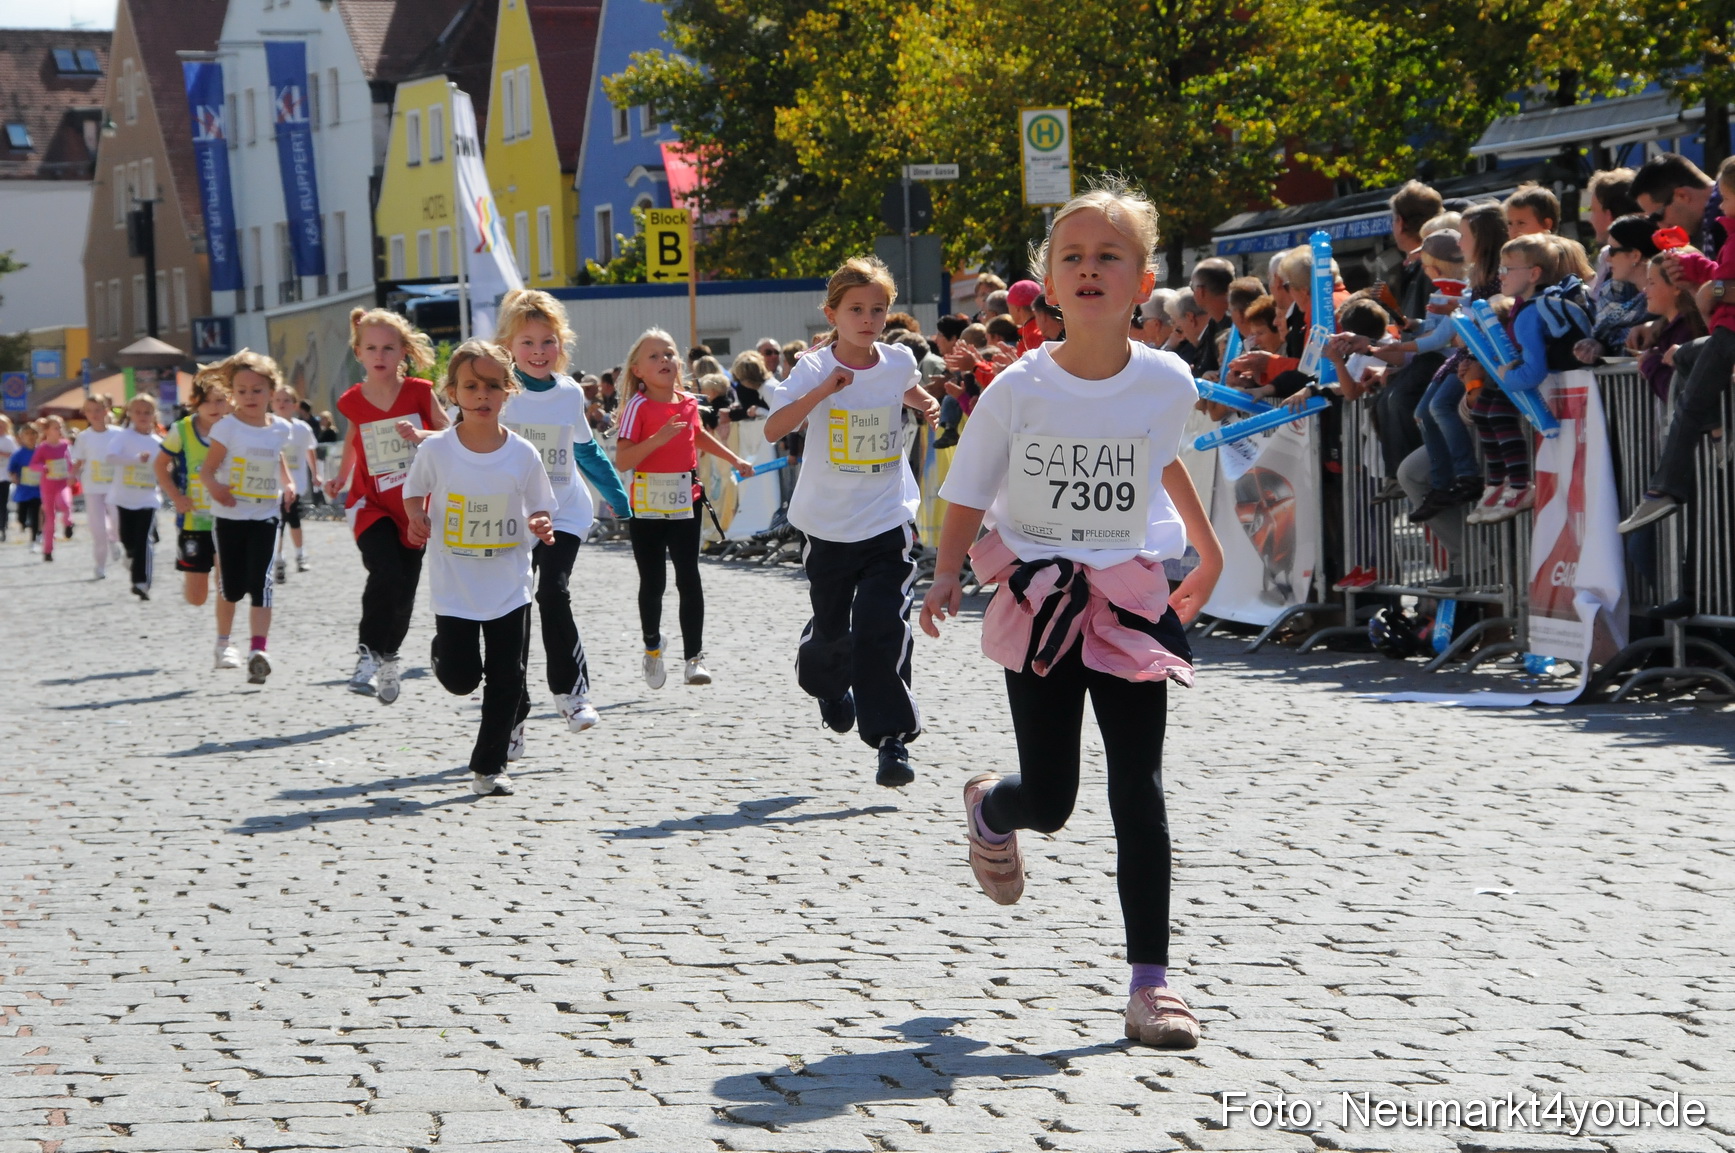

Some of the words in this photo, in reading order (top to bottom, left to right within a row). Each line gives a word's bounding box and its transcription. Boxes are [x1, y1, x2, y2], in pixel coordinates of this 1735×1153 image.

[290, 131, 317, 212] RUPPERT
[422, 194, 448, 219] HOTEL
[650, 212, 688, 225] Block
[658, 231, 682, 266] B
[851, 413, 879, 427] Paula
[375, 425, 395, 436] Laur
[523, 428, 546, 441] Alina
[832, 433, 843, 443] K3
[853, 430, 897, 453] 7137
[539, 448, 567, 465] 188
[1023, 442, 1135, 478] SARAH
[649, 491, 687, 504] 7195
[1049, 480, 1135, 511] 7309
[467, 501, 488, 513] Lisa
[468, 518, 517, 537] 7110
[1085, 529, 1130, 538] PFLEIDERER
